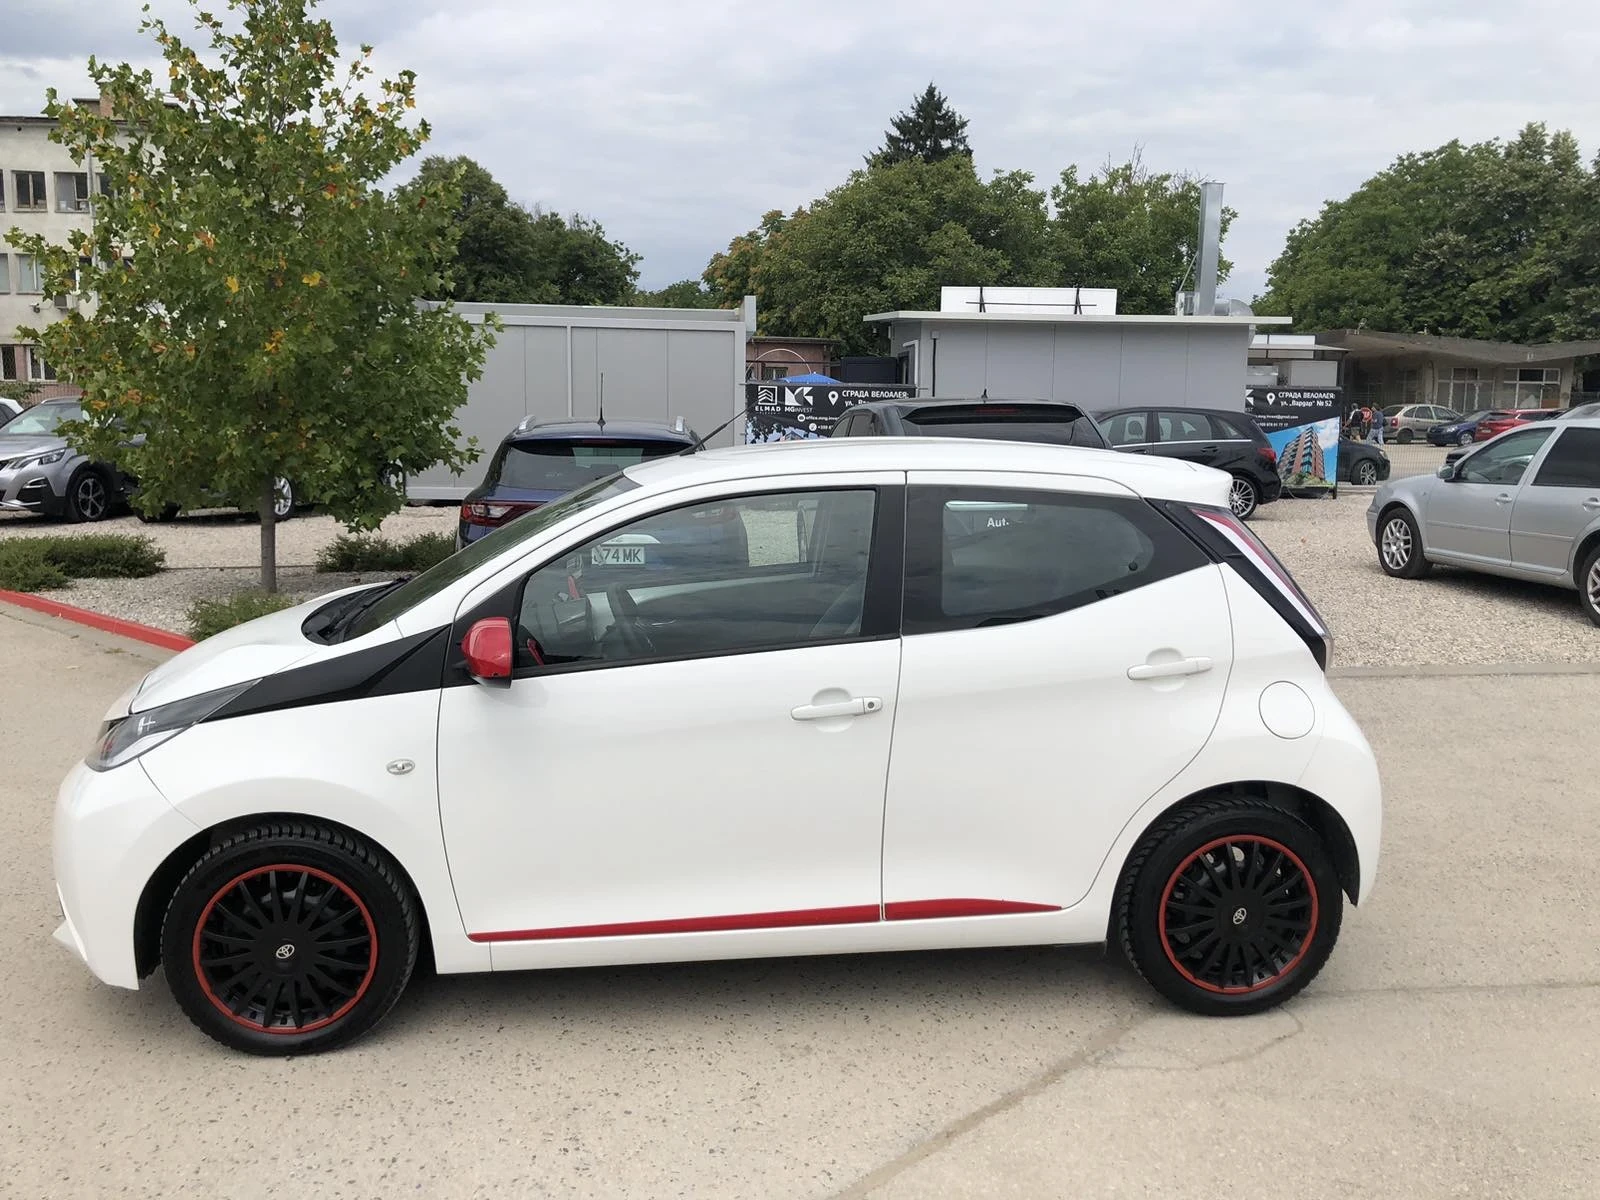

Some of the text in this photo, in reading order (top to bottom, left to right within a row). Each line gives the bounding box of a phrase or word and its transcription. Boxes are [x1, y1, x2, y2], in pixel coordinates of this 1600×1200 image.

[842, 390, 869, 398] СГРАДА
[1278, 391, 1302, 399] СГРАДА
[622, 548, 642, 562] MK
